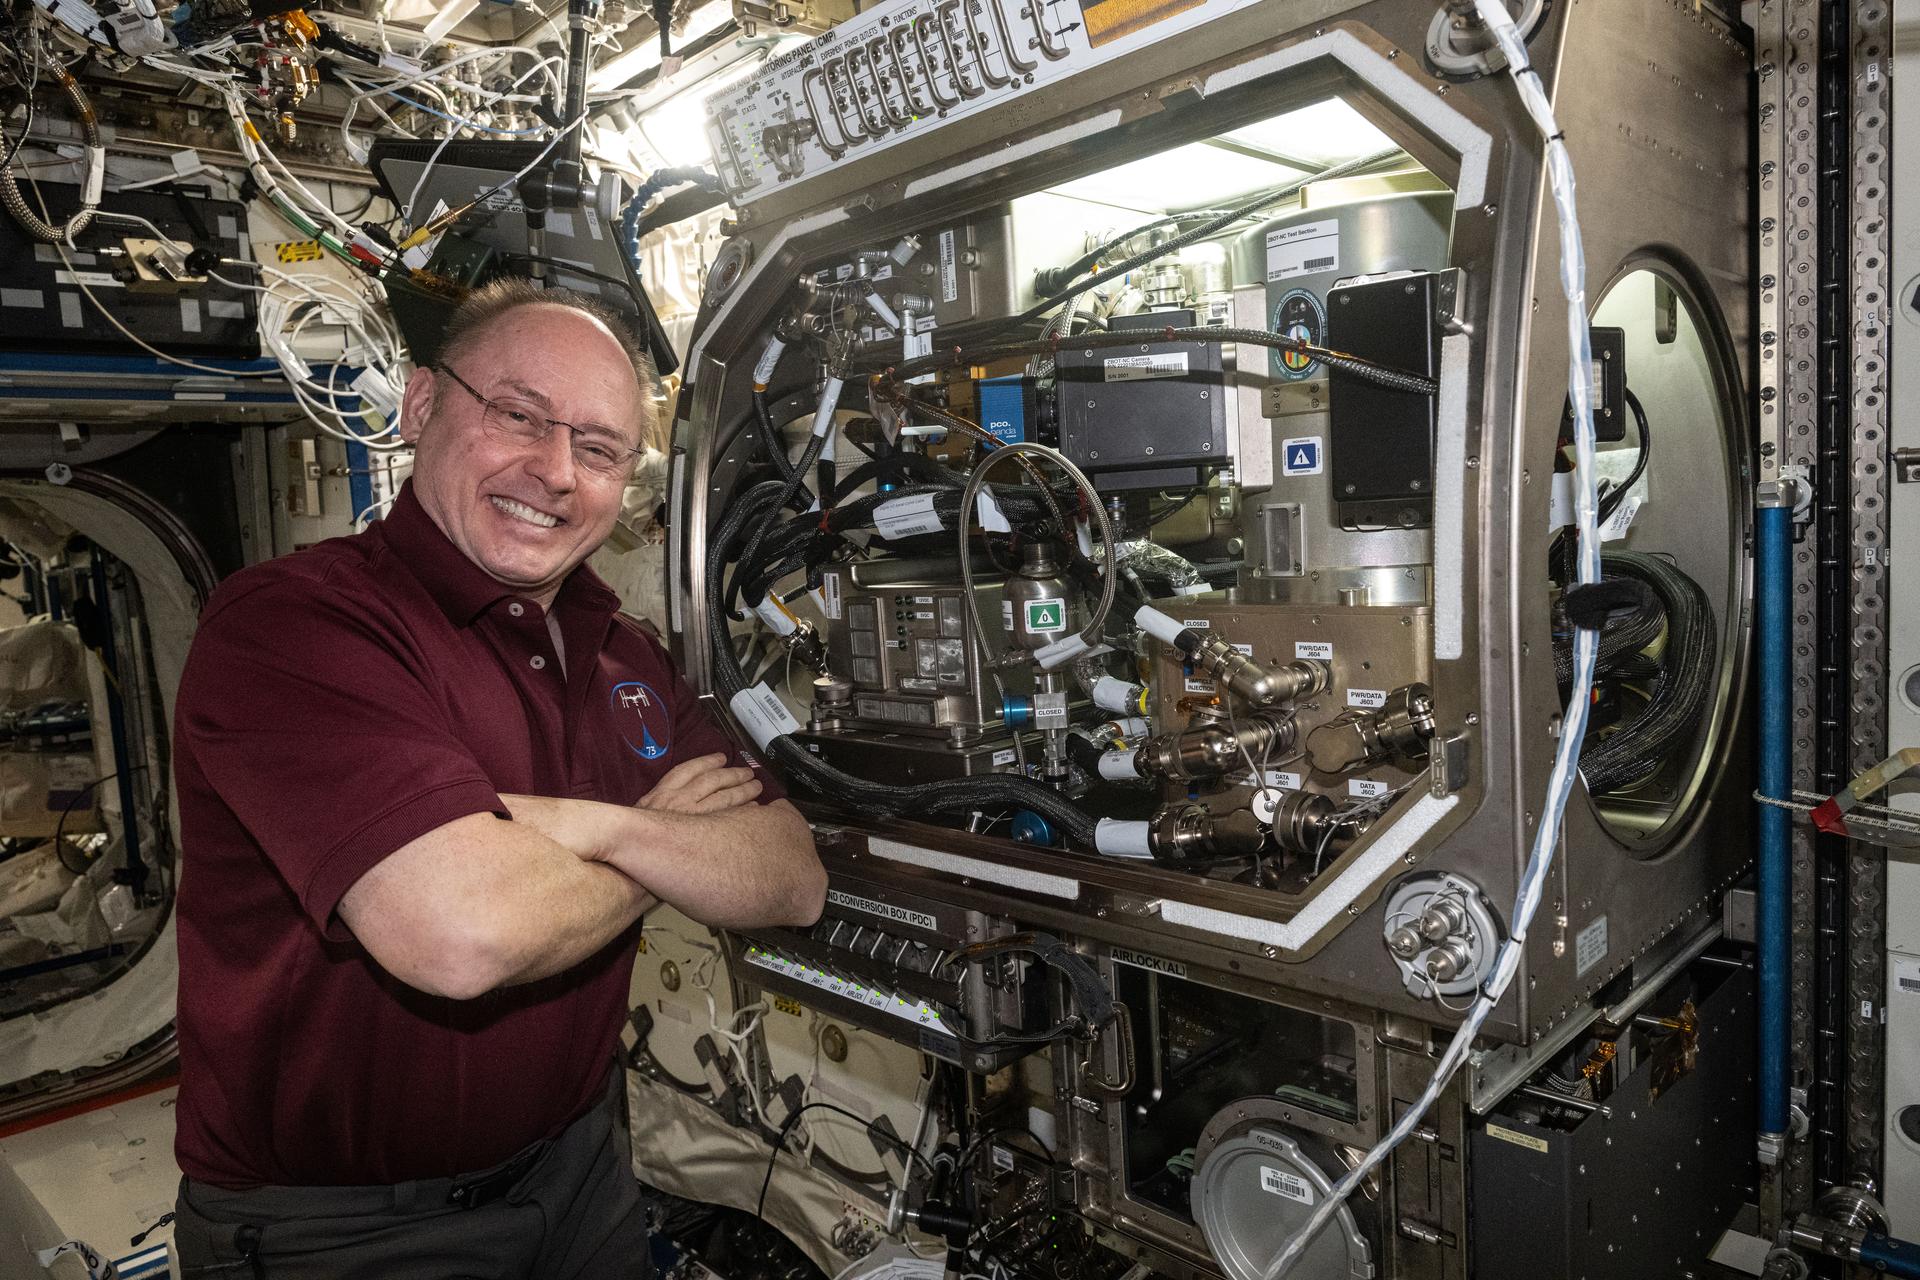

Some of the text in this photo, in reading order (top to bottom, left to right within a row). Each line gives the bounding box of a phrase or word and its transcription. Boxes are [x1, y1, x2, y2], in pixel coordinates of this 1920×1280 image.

[893, 6, 917, 24] FUNCTIONS
[844, 36, 859, 50] POWER
[859, 26, 878, 40] OUTLETS
[751, 51, 792, 81] MONITORING
[791, 43, 816, 61] PANEL
[815, 30, 836, 49] (CMP)
[1870, 64, 1877, 73] B
[765, 77, 776, 89] TEST
[1867, 311, 1875, 320] C
[990, 421, 1011, 430] pco.
[1298, 453, 1303, 464] 1
[1867, 549, 1874, 557] D
[1042, 613, 1049, 623] 0
[1187, 684, 1215, 692] INJECTION
[1350, 691, 1383, 700] PWR/DATA
[646, 745, 657, 756] 73
[1275, 773, 1290, 781] DATA
[1359, 782, 1376, 790] DATA
[839, 895, 889, 916] CONVERSION
[890, 906, 908, 920] BOX
[909, 912, 933, 928] (PDC)
[1111, 948, 1162, 970] AIRLOCK
[794, 970, 802, 978] FAN
[846, 990, 863, 1000] AIRLOCK
[919, 1015, 930, 1023] CMP
